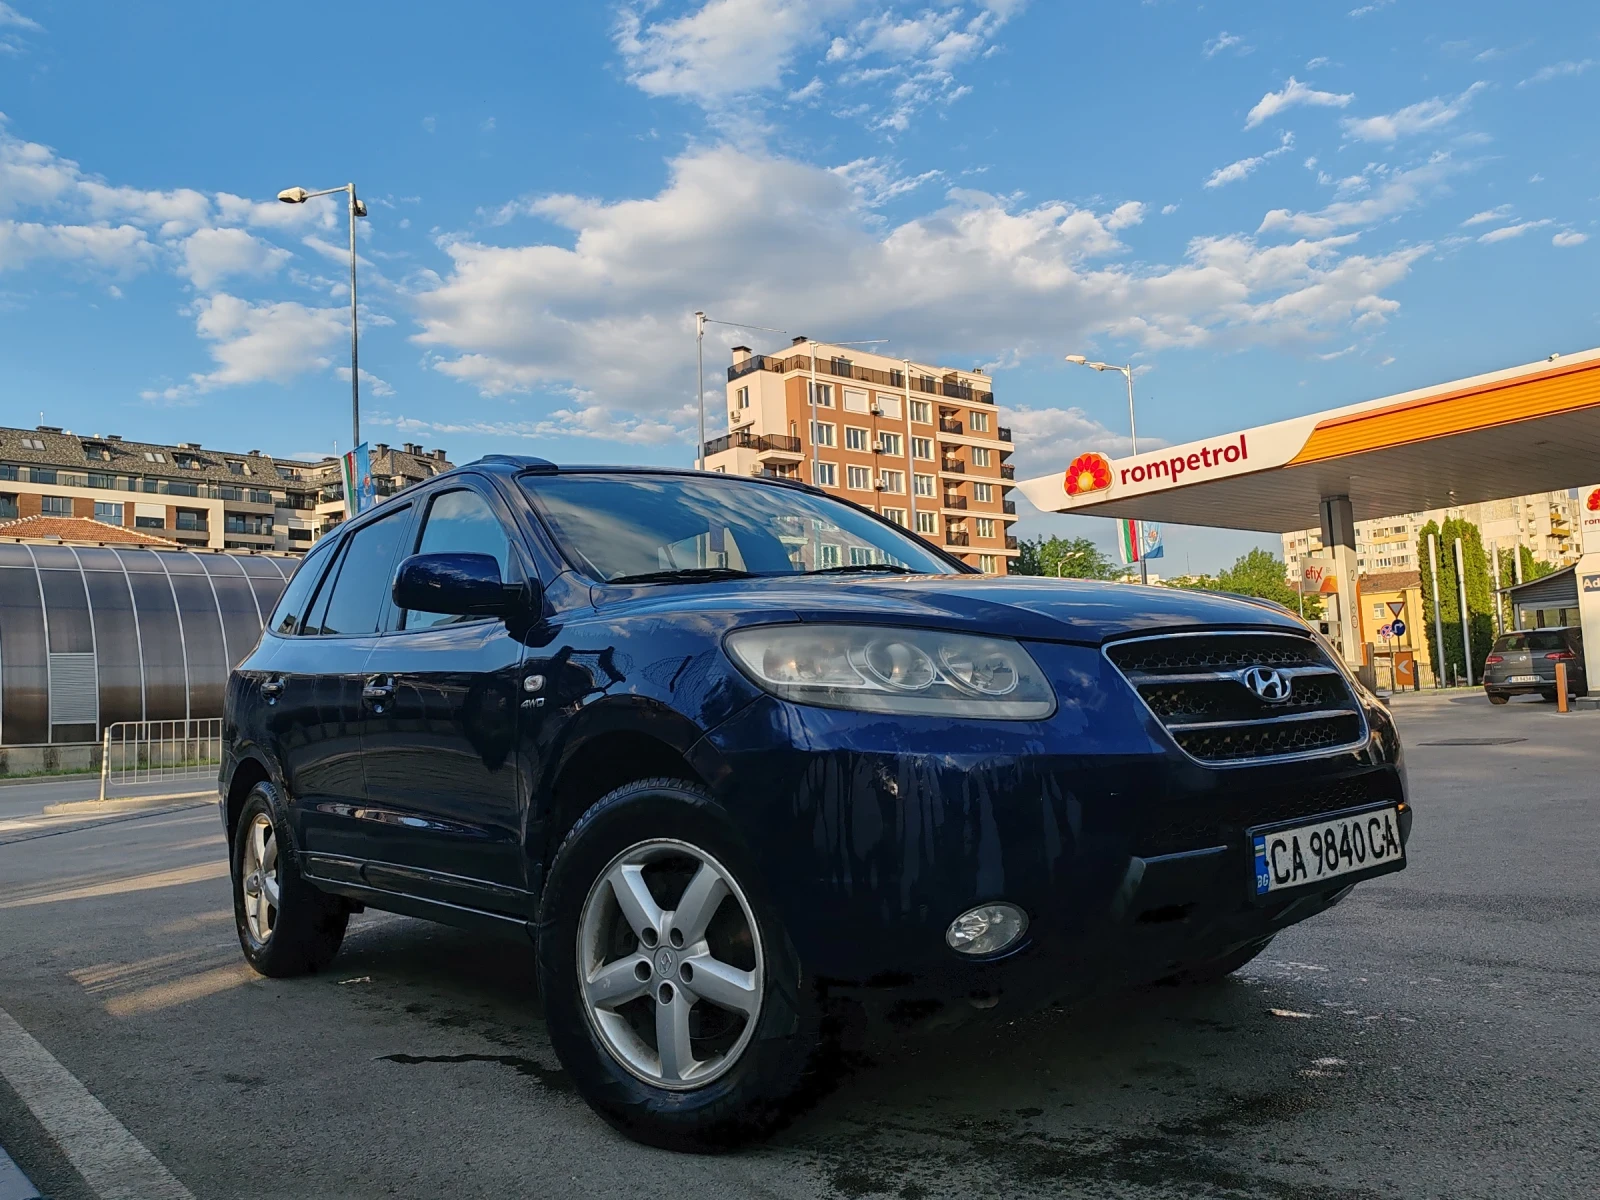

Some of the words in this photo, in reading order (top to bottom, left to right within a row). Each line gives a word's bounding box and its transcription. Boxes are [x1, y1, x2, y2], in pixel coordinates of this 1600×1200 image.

[1120, 434, 1248, 485] rompetrol
[1305, 566, 1323, 583] efix
[1350, 569, 1356, 582] 2
[521, 697, 545, 709] 4WD
[1271, 836, 1308, 885] CA
[1310, 822, 1366, 876] 9840
[1367, 815, 1399, 859] CA
[1257, 874, 1269, 888] BG
